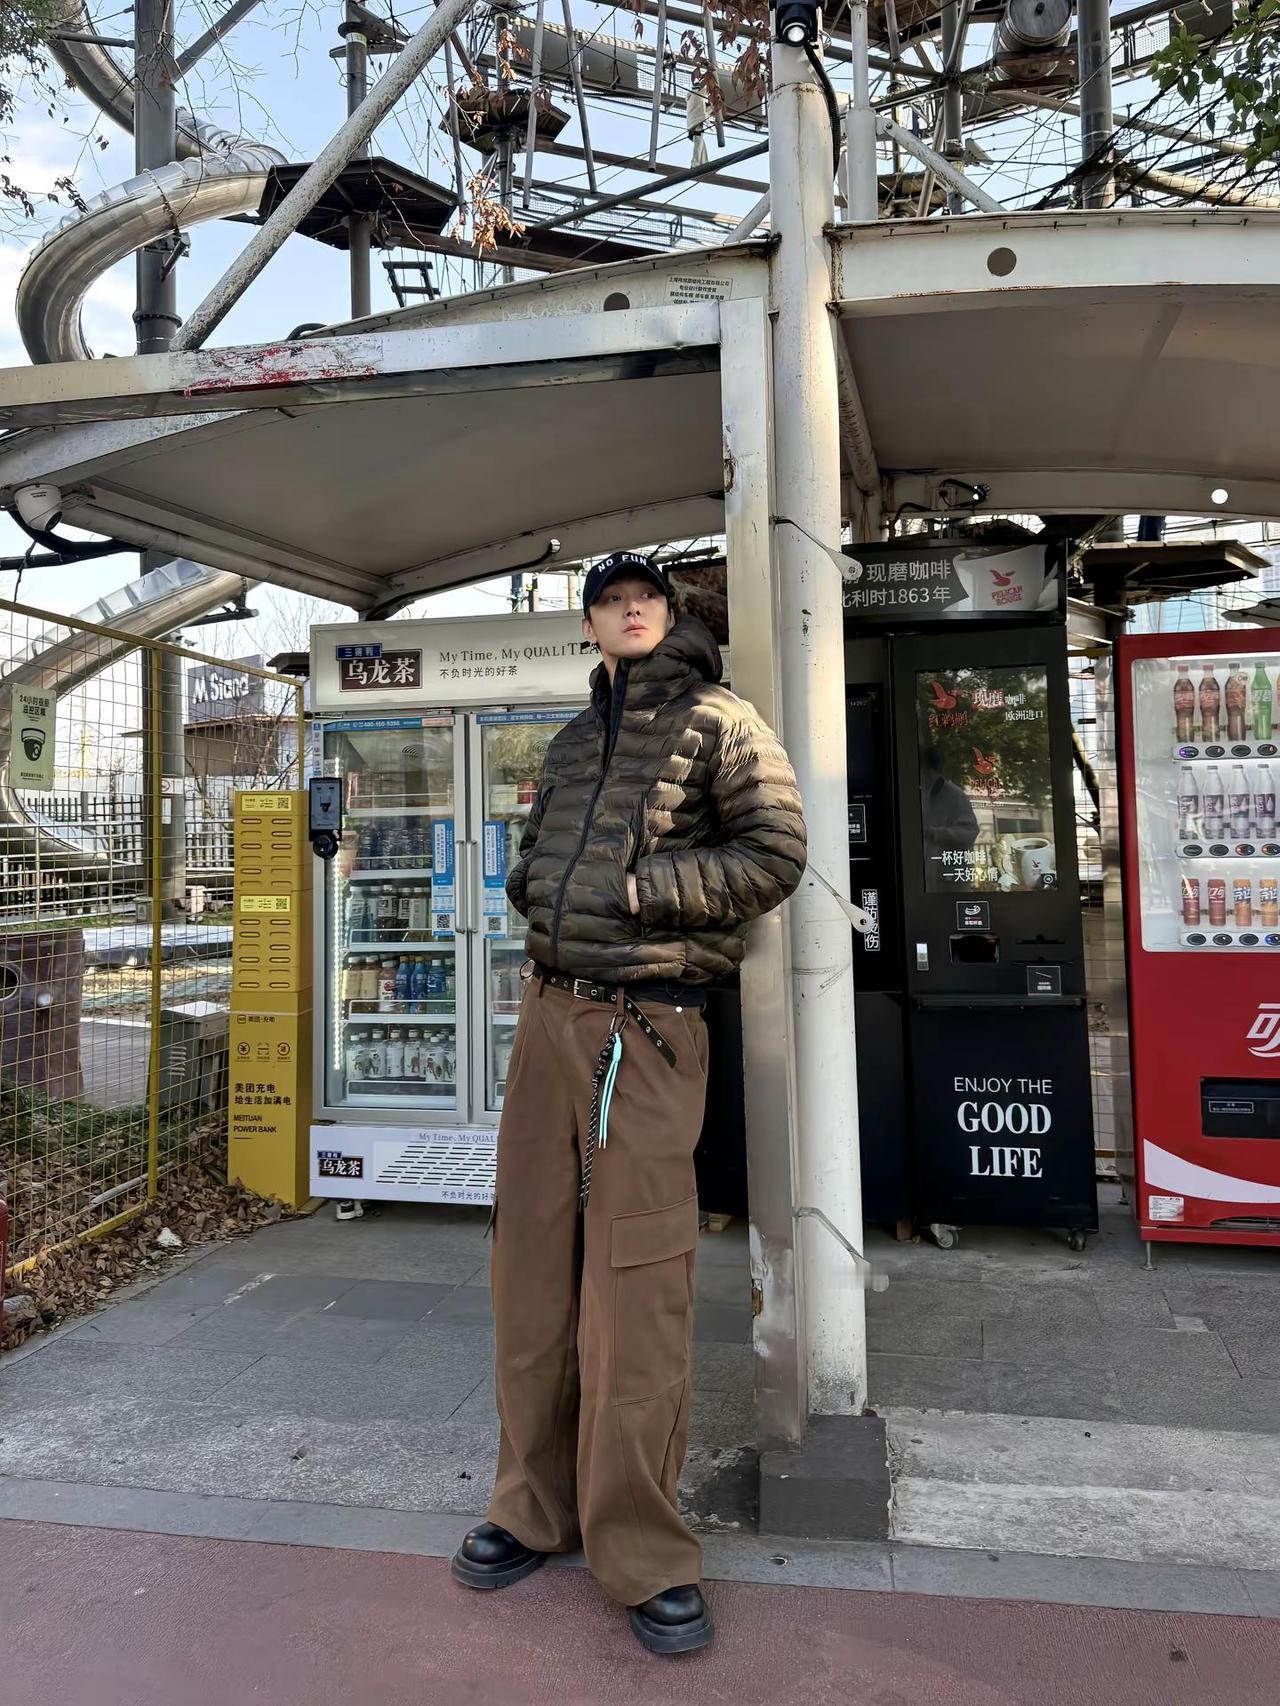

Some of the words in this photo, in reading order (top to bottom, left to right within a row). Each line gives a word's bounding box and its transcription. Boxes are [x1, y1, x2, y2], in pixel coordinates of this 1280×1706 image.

[597, 558, 614, 573] NO
[621, 554, 647, 566] FUN
[867, 560, 951, 582] 现磨咖啡
[992, 585, 1023, 599] PELICAN
[440, 651, 458, 665] My
[461, 649, 497, 662] Time,
[502, 647, 521, 662] My
[345, 657, 416, 686] 乌龙茶
[439, 665, 518, 679] 不负时光的好茶
[192, 676, 209, 704] M
[1005, 710, 1044, 721] 欧洲进口
[931, 850, 987, 865] 一杯好咖啡
[943, 867, 999, 883] 一天好心情
[234, 1083, 276, 1094] 美团充电
[953, 1076, 1013, 1094] ENJOY
[1018, 1078, 1053, 1095] THE
[234, 1095, 292, 1106] 给生活加满电
[233, 1114, 262, 1122] MEITUAN
[956, 1101, 1052, 1135] GOOD
[233, 1125, 257, 1133] POWER
[419, 1132, 431, 1142] My
[458, 1134, 471, 1143] My
[320, 1158, 361, 1176] 乌龙茶
[968, 1145, 1043, 1179] LIFE
